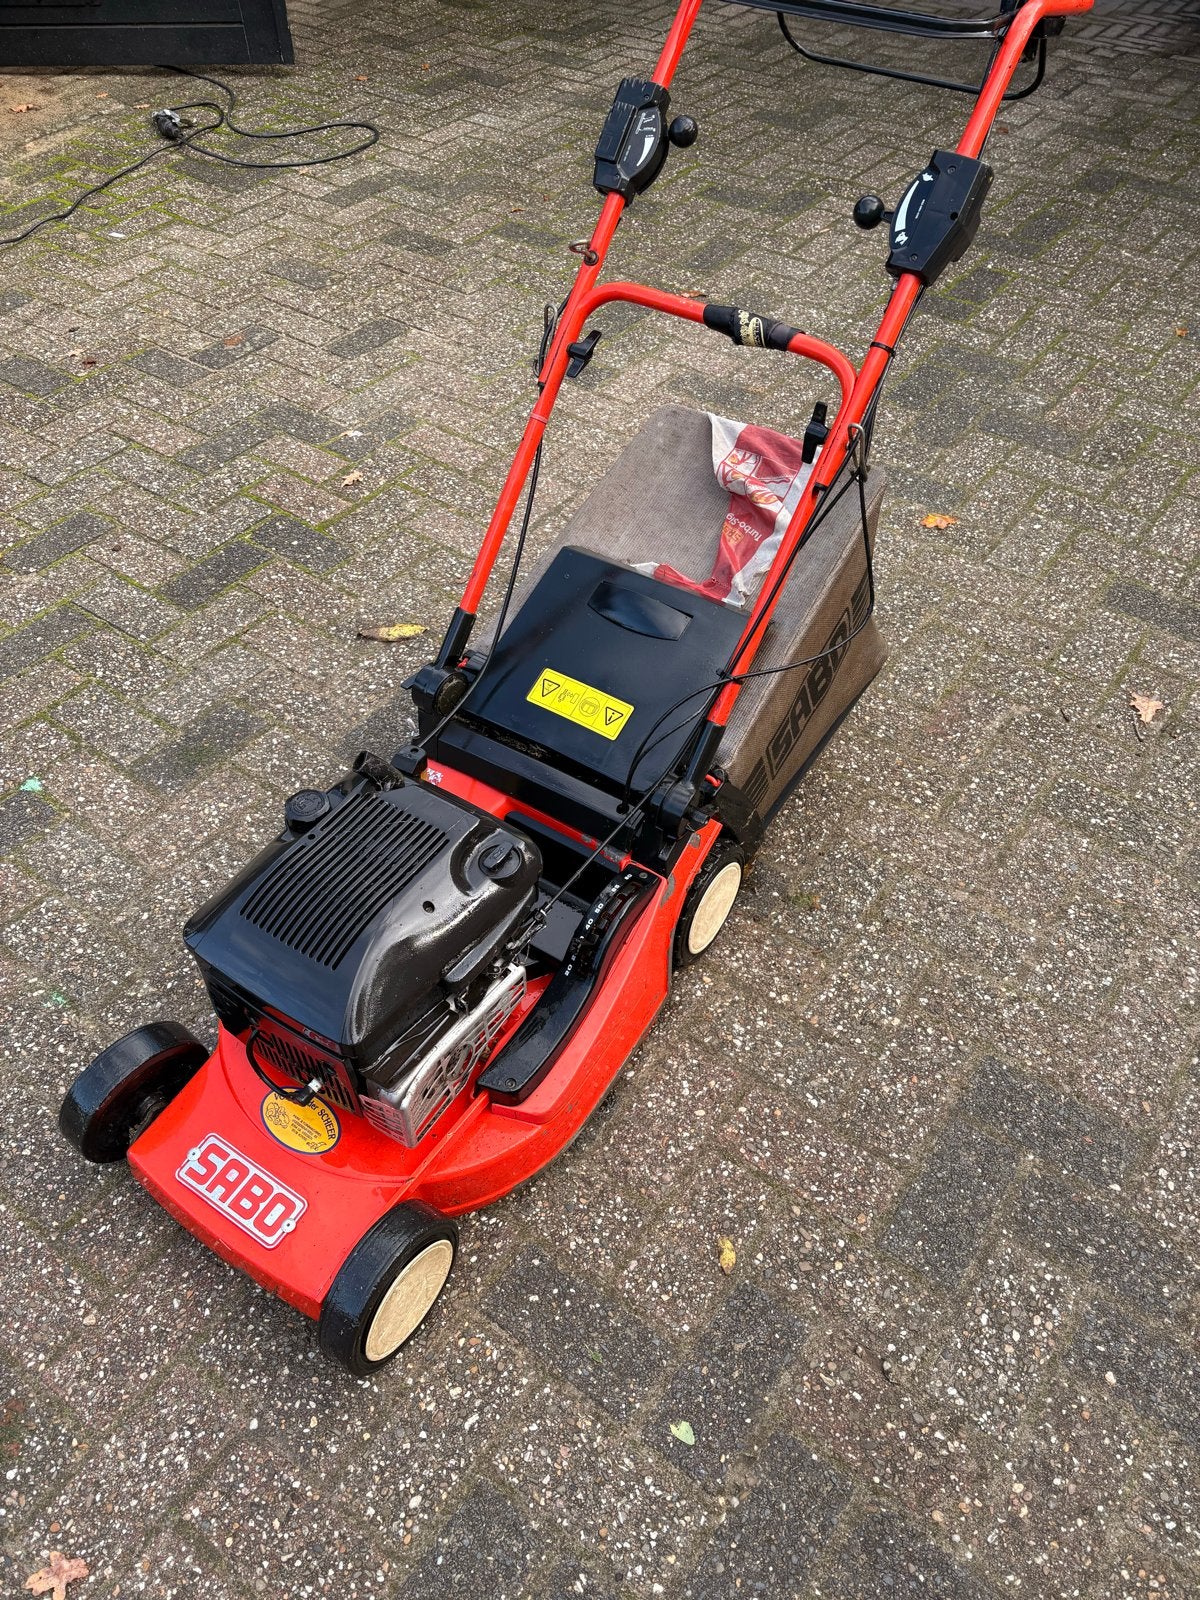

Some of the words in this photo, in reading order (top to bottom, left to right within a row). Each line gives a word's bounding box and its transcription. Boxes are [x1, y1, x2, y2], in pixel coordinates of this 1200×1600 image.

[770, 620, 850, 767] SABO
[585, 918, 594, 930] 40
[317, 1108, 336, 1141] SCHEER
[184, 1142, 297, 1238] SABO
